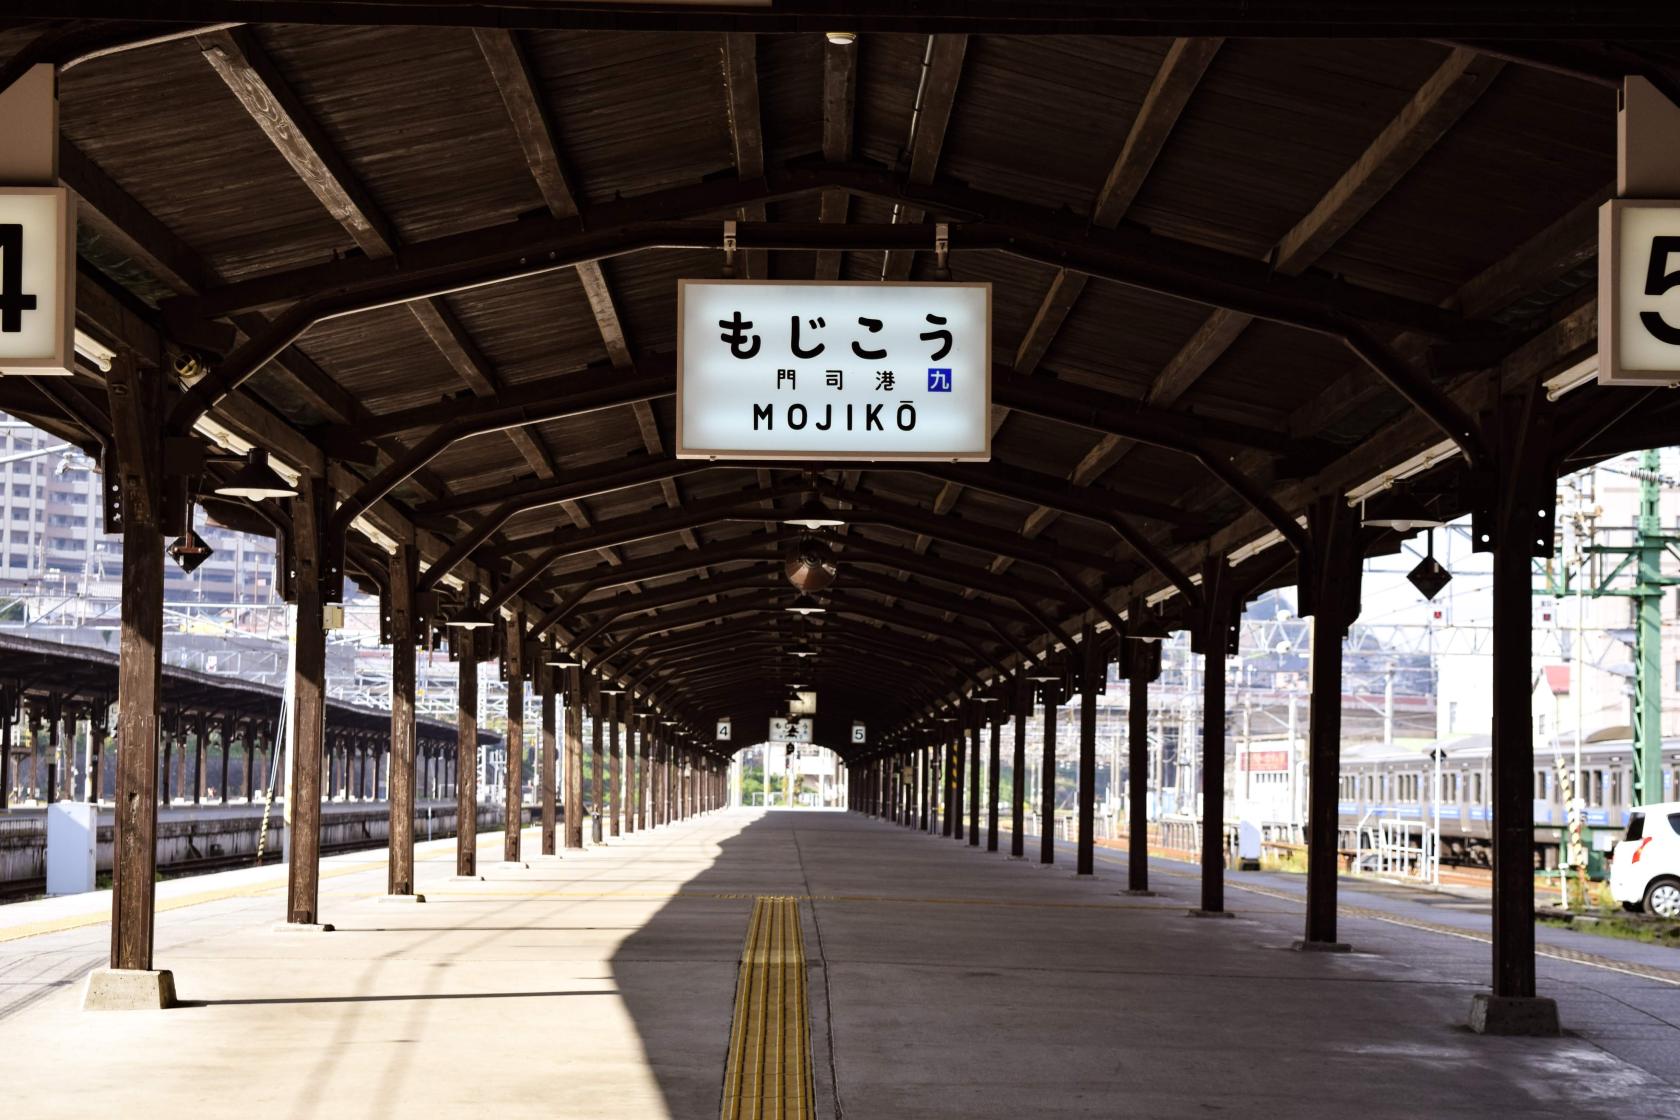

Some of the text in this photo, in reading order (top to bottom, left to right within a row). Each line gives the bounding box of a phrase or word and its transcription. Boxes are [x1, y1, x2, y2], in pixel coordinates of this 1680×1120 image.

[718, 311, 953, 362] もじこう
[777, 369, 895, 391] 門司港
[929, 370, 950, 391] 九
[753, 400, 917, 432] MOJIKŌ
[719, 726, 728, 737] 4
[855, 729, 864, 740] 5
